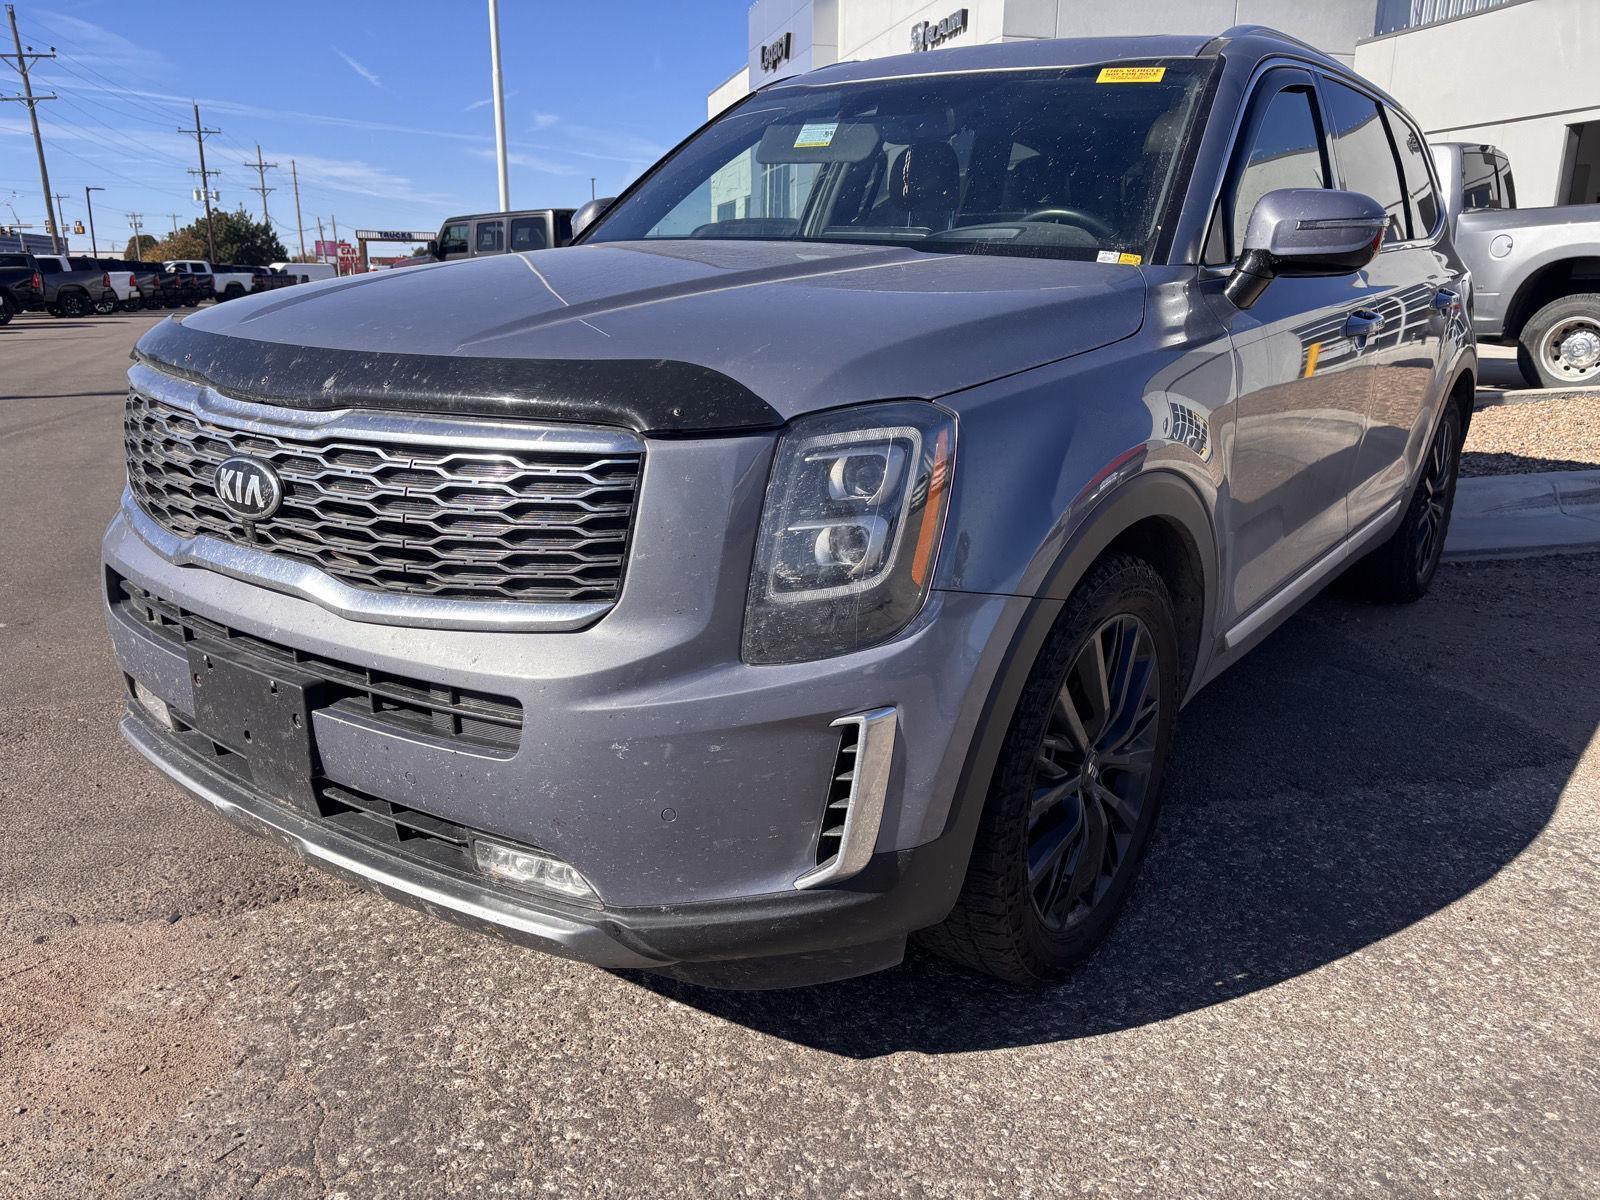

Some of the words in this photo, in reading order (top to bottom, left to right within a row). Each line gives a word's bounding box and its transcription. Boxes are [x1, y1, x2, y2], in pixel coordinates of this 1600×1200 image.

[925, 8, 968, 47] RAM
[761, 32, 792, 72] Legacy
[379, 231, 412, 239] TRUCKS
[219, 468, 265, 508] KIA
